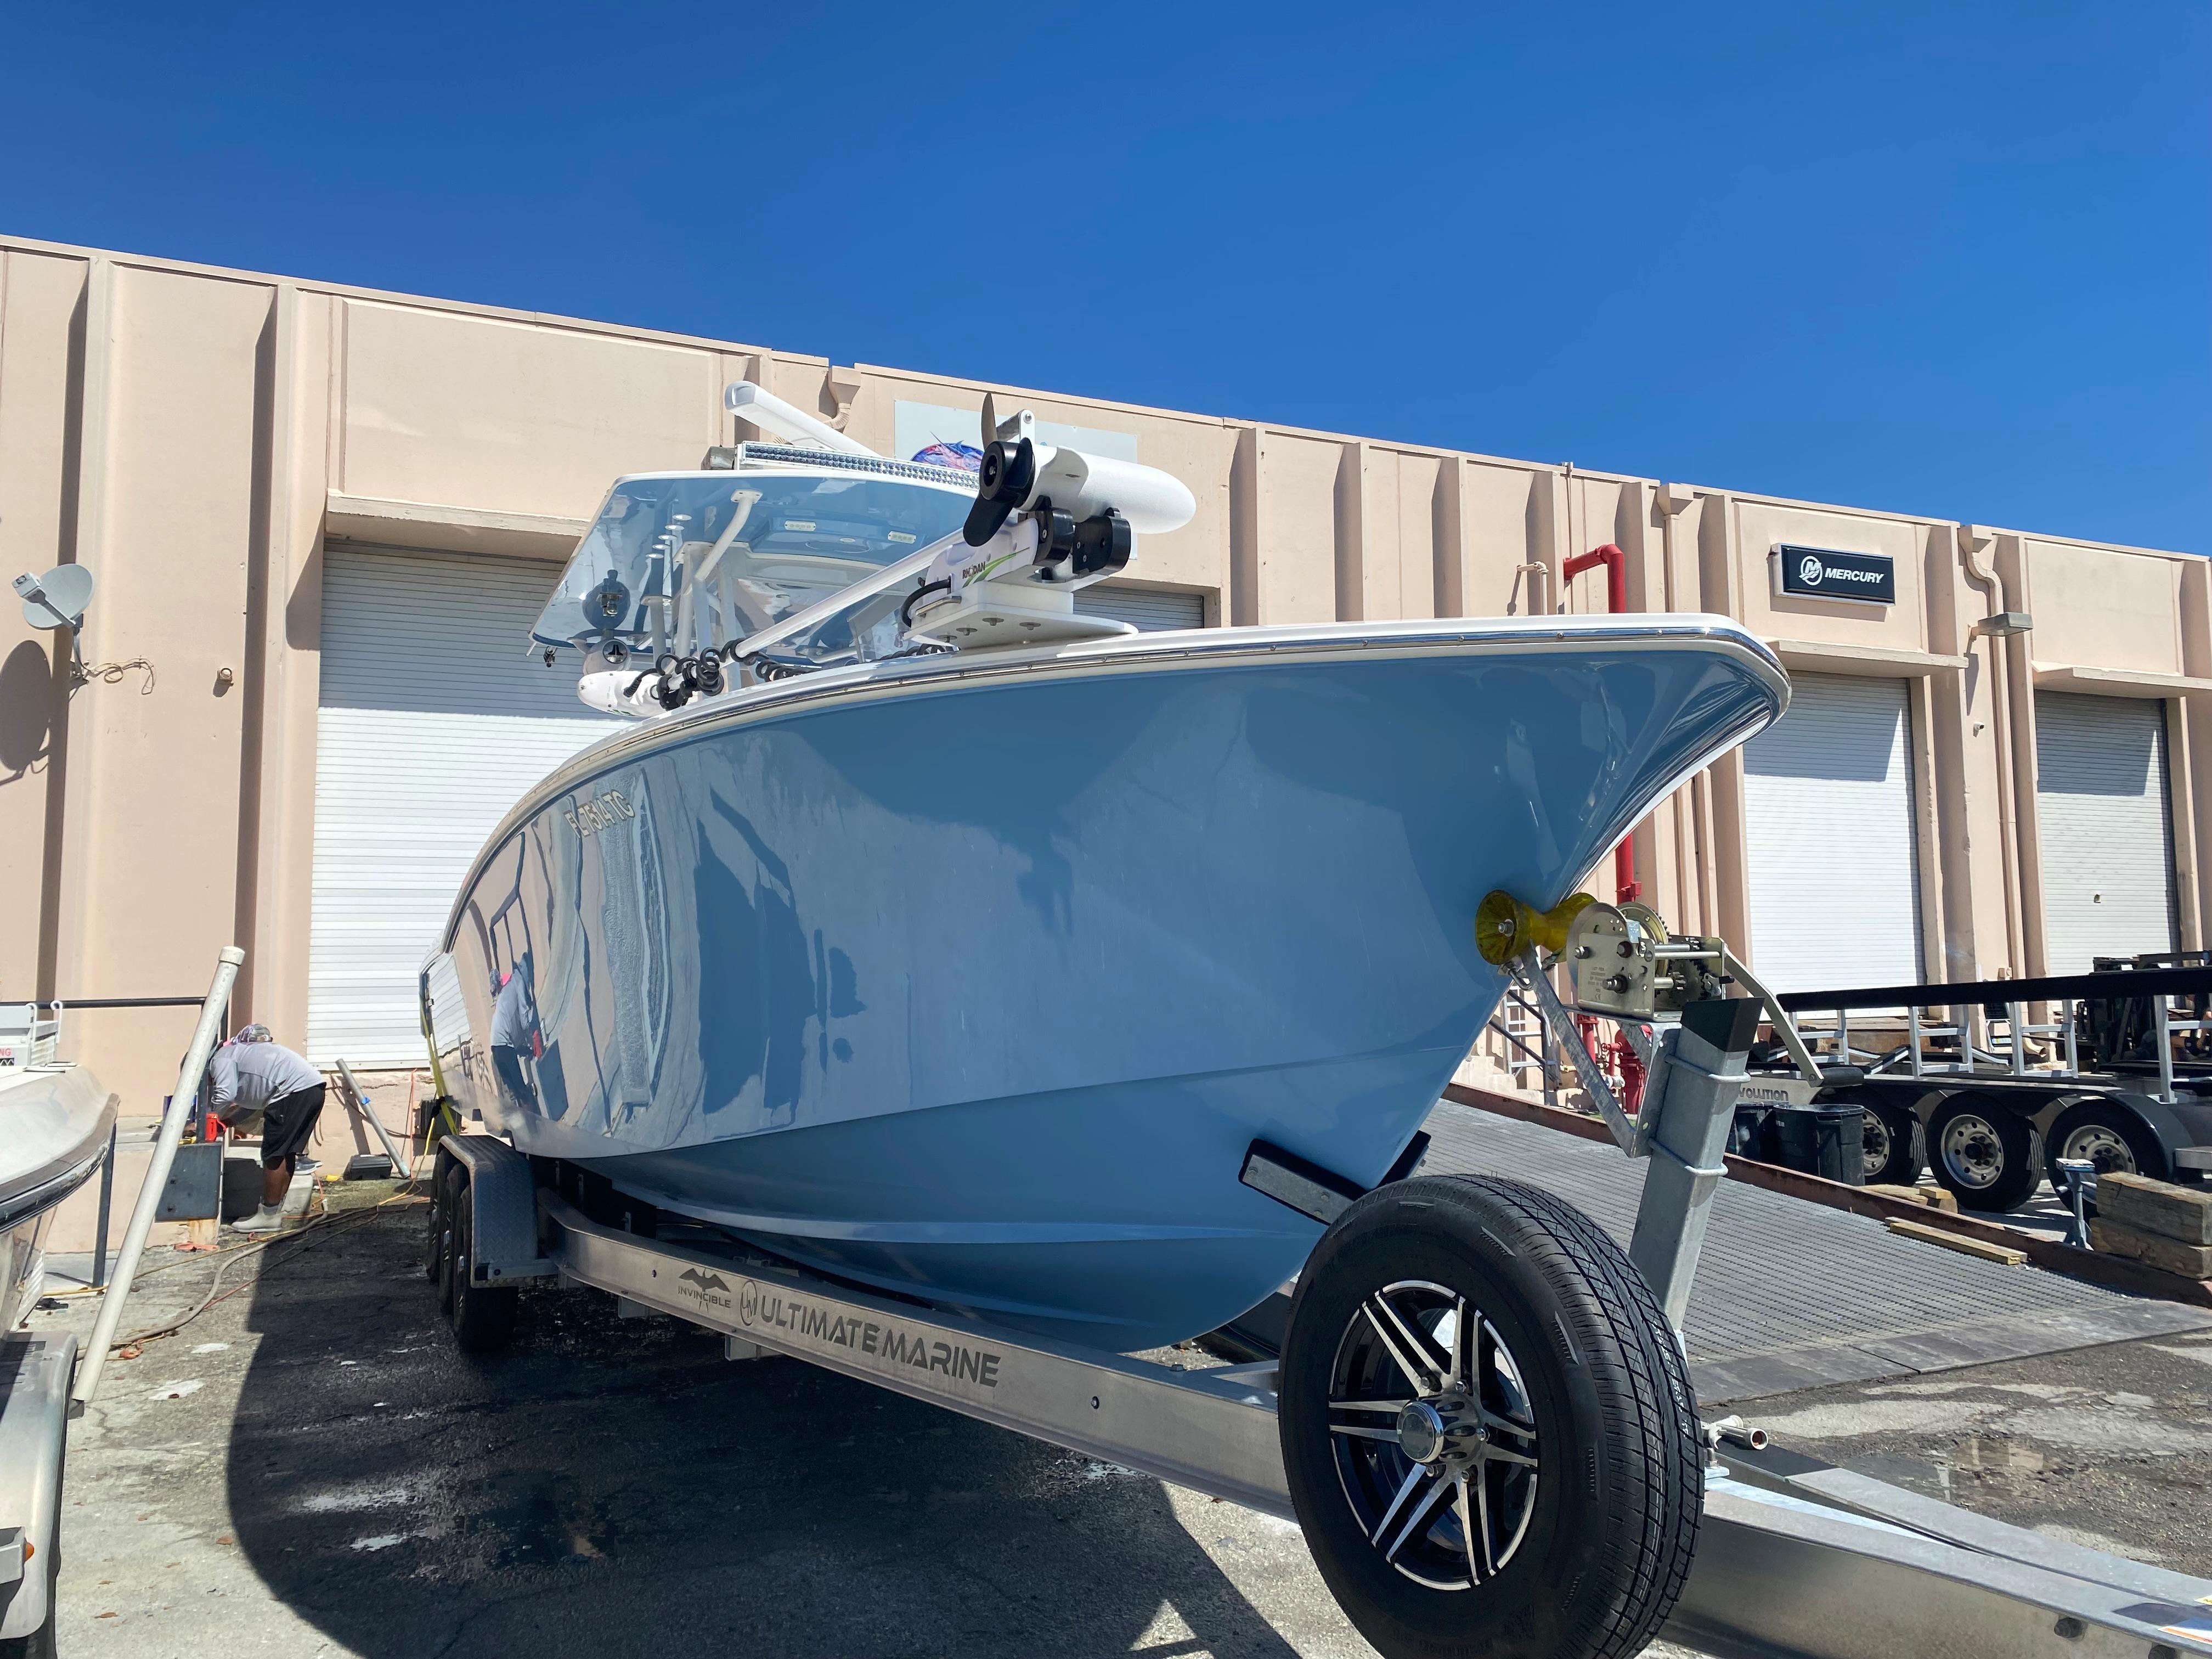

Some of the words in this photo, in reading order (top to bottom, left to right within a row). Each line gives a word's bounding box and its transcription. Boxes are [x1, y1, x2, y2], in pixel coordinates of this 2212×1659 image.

[1825, 567, 1884, 584] MERCURY
[564, 811, 589, 838] FL
[602, 789, 635, 820] TC
[1739, 1087, 1788, 1101] VOLUTION
[678, 1285, 731, 1309] INVINCIBLE
